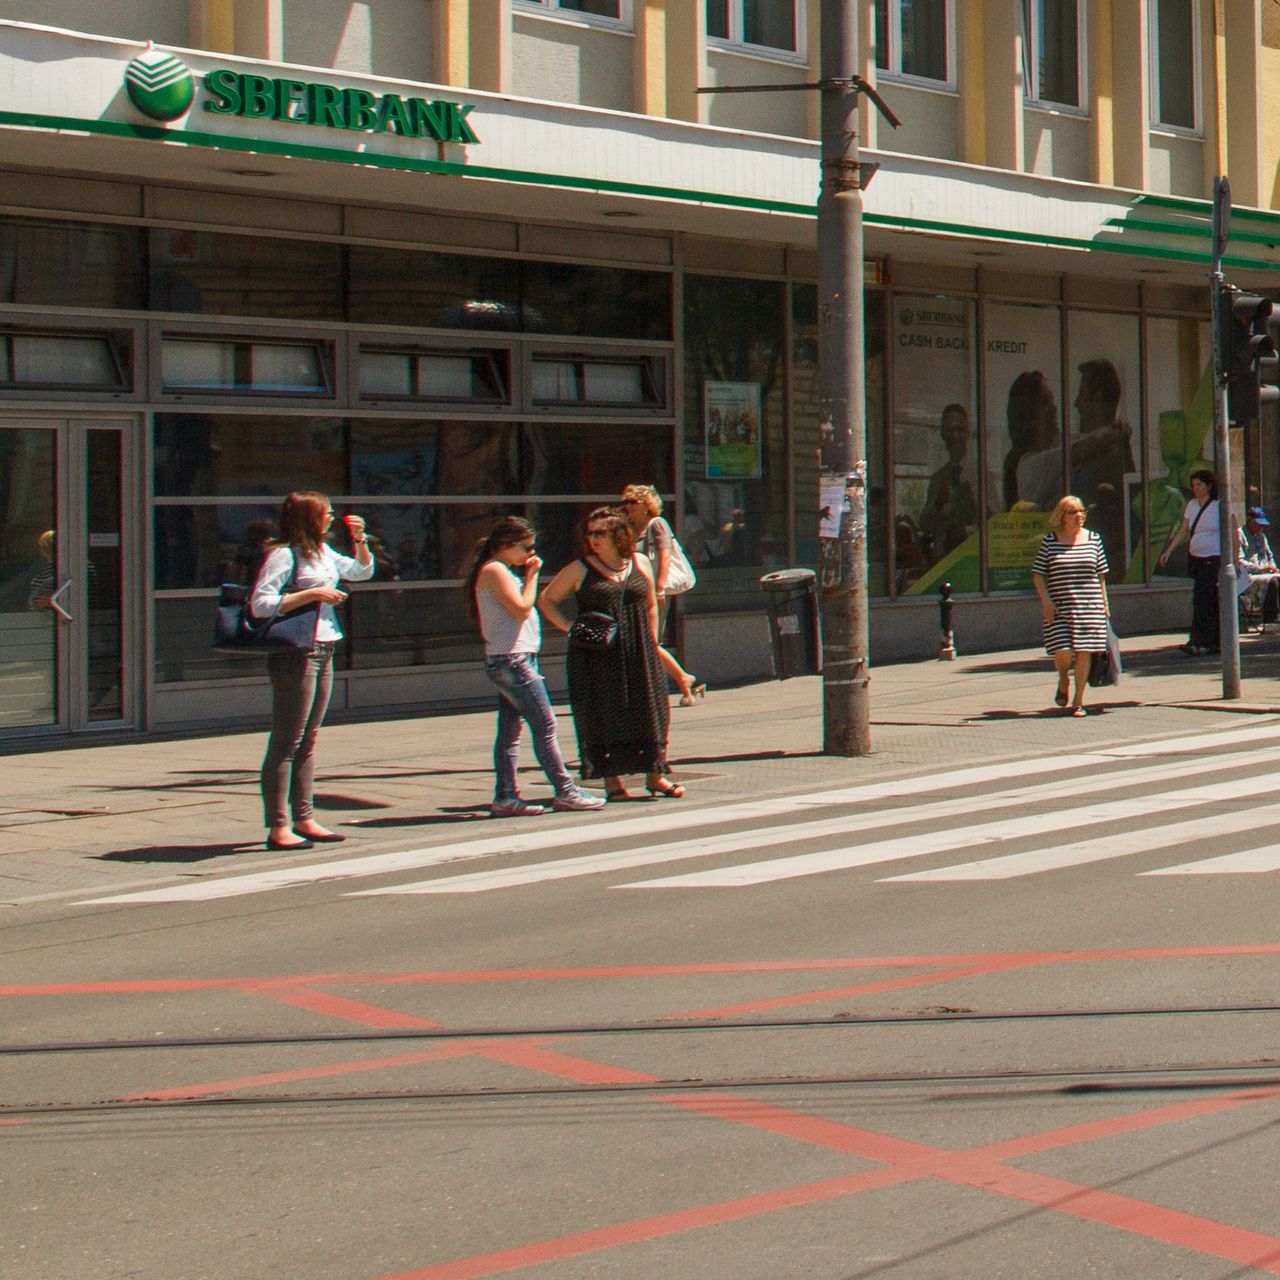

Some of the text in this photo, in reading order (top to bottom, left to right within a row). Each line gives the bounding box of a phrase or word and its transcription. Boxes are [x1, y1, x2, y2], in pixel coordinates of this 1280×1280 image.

[204, 70, 481, 144] SBERBANK
[900, 334, 1028, 354] CASH BACK KREDIT
